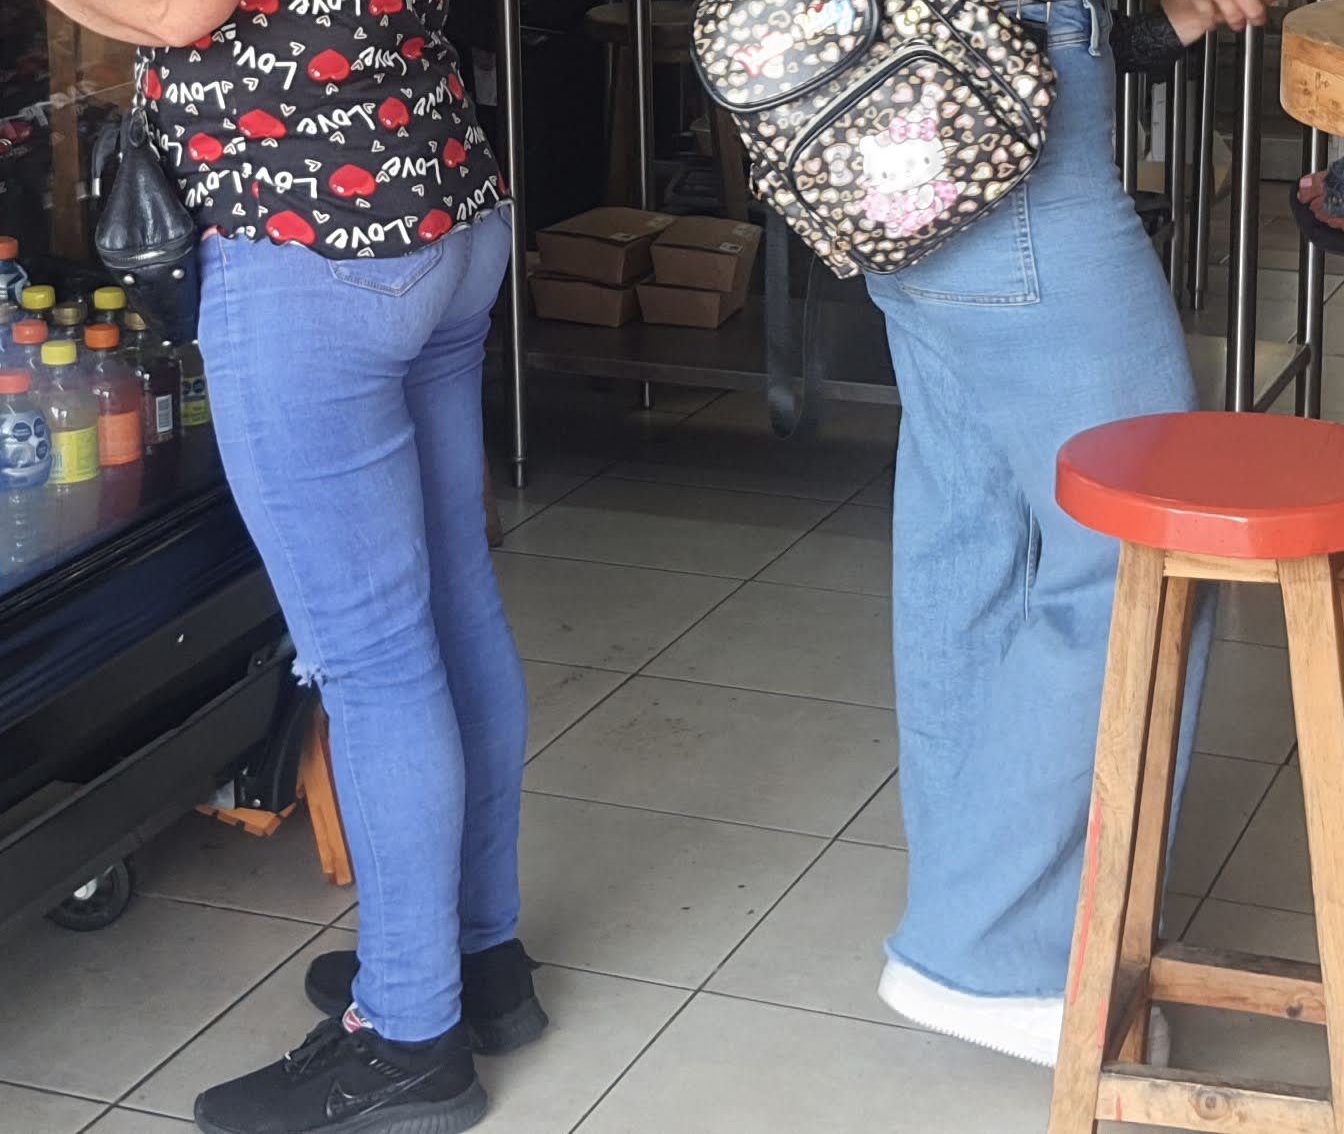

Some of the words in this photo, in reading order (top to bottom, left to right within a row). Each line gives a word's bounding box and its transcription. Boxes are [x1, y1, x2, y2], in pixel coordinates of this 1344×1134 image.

[165, 81, 226, 109] Love
[296, 103, 376, 136] Love
[382, 156, 442, 185] Love
[456, 179, 501, 221] Love
[325, 218, 411, 248] Love
